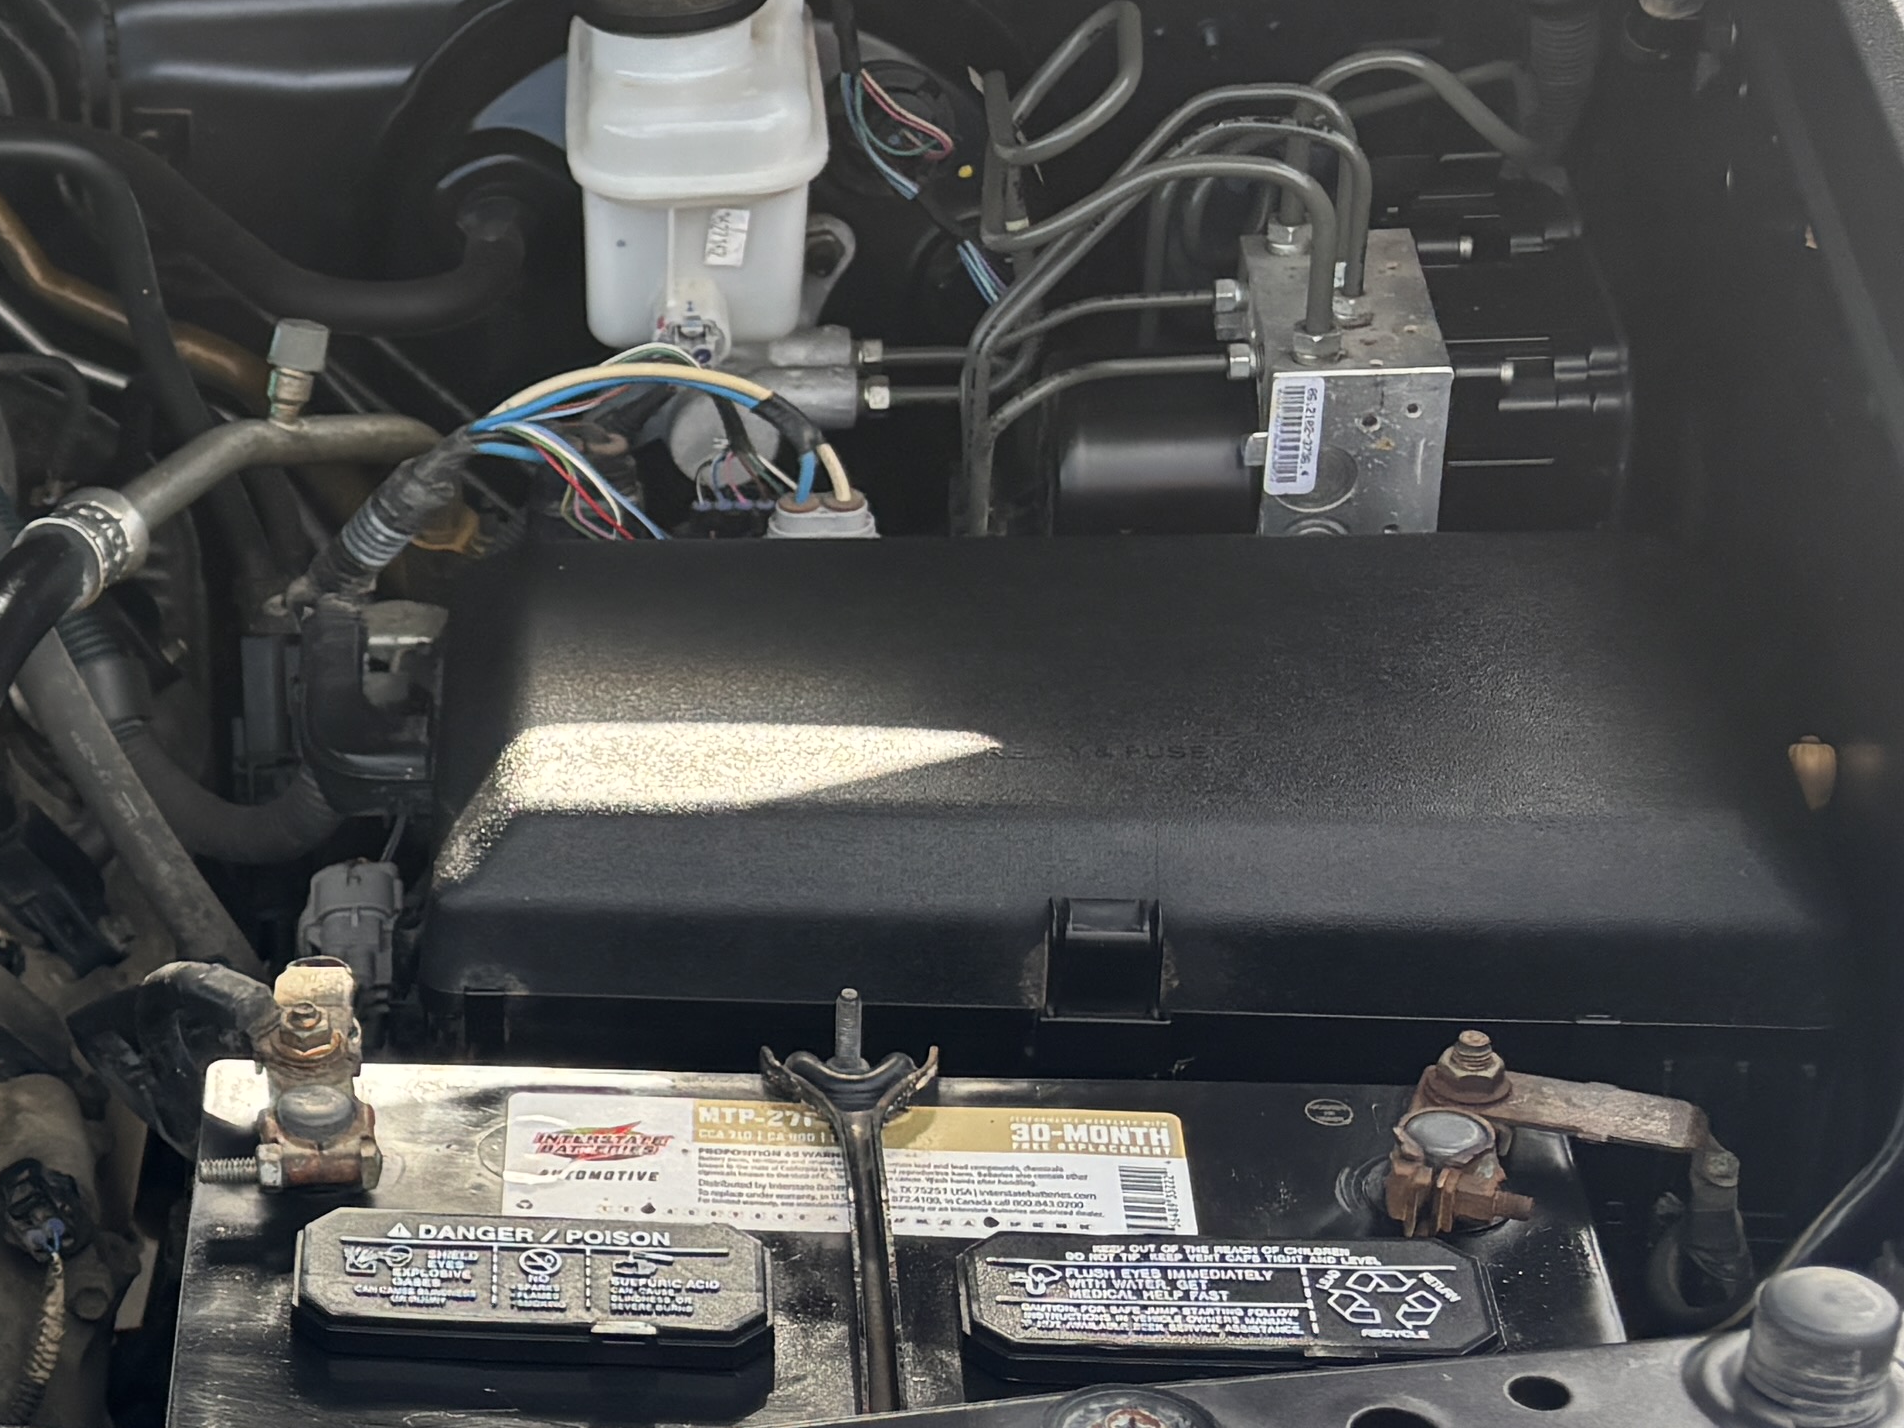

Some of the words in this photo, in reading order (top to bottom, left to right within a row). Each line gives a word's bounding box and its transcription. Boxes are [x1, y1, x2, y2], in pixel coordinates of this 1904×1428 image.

[1010, 1122, 1171, 1148] 30-MONTH
[801, 1150, 842, 1159] WARN
[1011, 1142, 1049, 1151] FREE
[1057, 1142, 1172, 1156] REPLACEMENT
[900, 1185, 913, 1194] TX
[418, 1223, 535, 1243] DANGER
[565, 1228, 671, 1247] POISON
[427, 1249, 480, 1262] SHIELD
[1092, 1243, 1126, 1253] KEEP
[1128, 1244, 1156, 1254] OUT
[1160, 1244, 1179, 1254] OF
[1183, 1244, 1209, 1254] THE
[1214, 1245, 1258, 1255] REACH
[1261, 1245, 1280, 1255] OF
[1283, 1246, 1350, 1257] CHILDREN
[427, 1259, 465, 1270] EYES
[1065, 1251, 1085, 1261] DO
[1088, 1252, 1116, 1262] NOT
[1148, 1253, 1183, 1262] KEEP
[1187, 1253, 1220, 1262] VENT
[1225, 1254, 1261, 1264] CAPS
[1265, 1254, 1303, 1264] TIGHT
[1316, 1255, 1339, 1265] AND
[392, 1267, 472, 1281] EXPLOSIVE
[528, 1274, 550, 1284] NO
[1065, 1267, 1116, 1279] FLUSH
[1121, 1268, 1161, 1280] EYES
[1167, 1269, 1274, 1282] IMMEDIATELY
[391, 1276, 442, 1288] GASES
[685, 1279, 720, 1290] ACID
[1066, 1278, 1107, 1289] WITH
[1176, 1279, 1209, 1291] GET
[1417, 1271, 1462, 1304] RETURN
[1069, 1288, 1138, 1301] MEDICAL
[1143, 1289, 1184, 1301] HELP
[1189, 1290, 1230, 1302] FAST
[1023, 1311, 1112, 1322] INSTRUCTIONS
[1080, 1303, 1106, 1314] FOR
[1144, 1305, 1179, 1316] JUMP
[1182, 1306, 1244, 1317] STARTING
[1246, 1307, 1299, 1318] FOLLOW
[1360, 1327, 1430, 1340] RECYCLE
